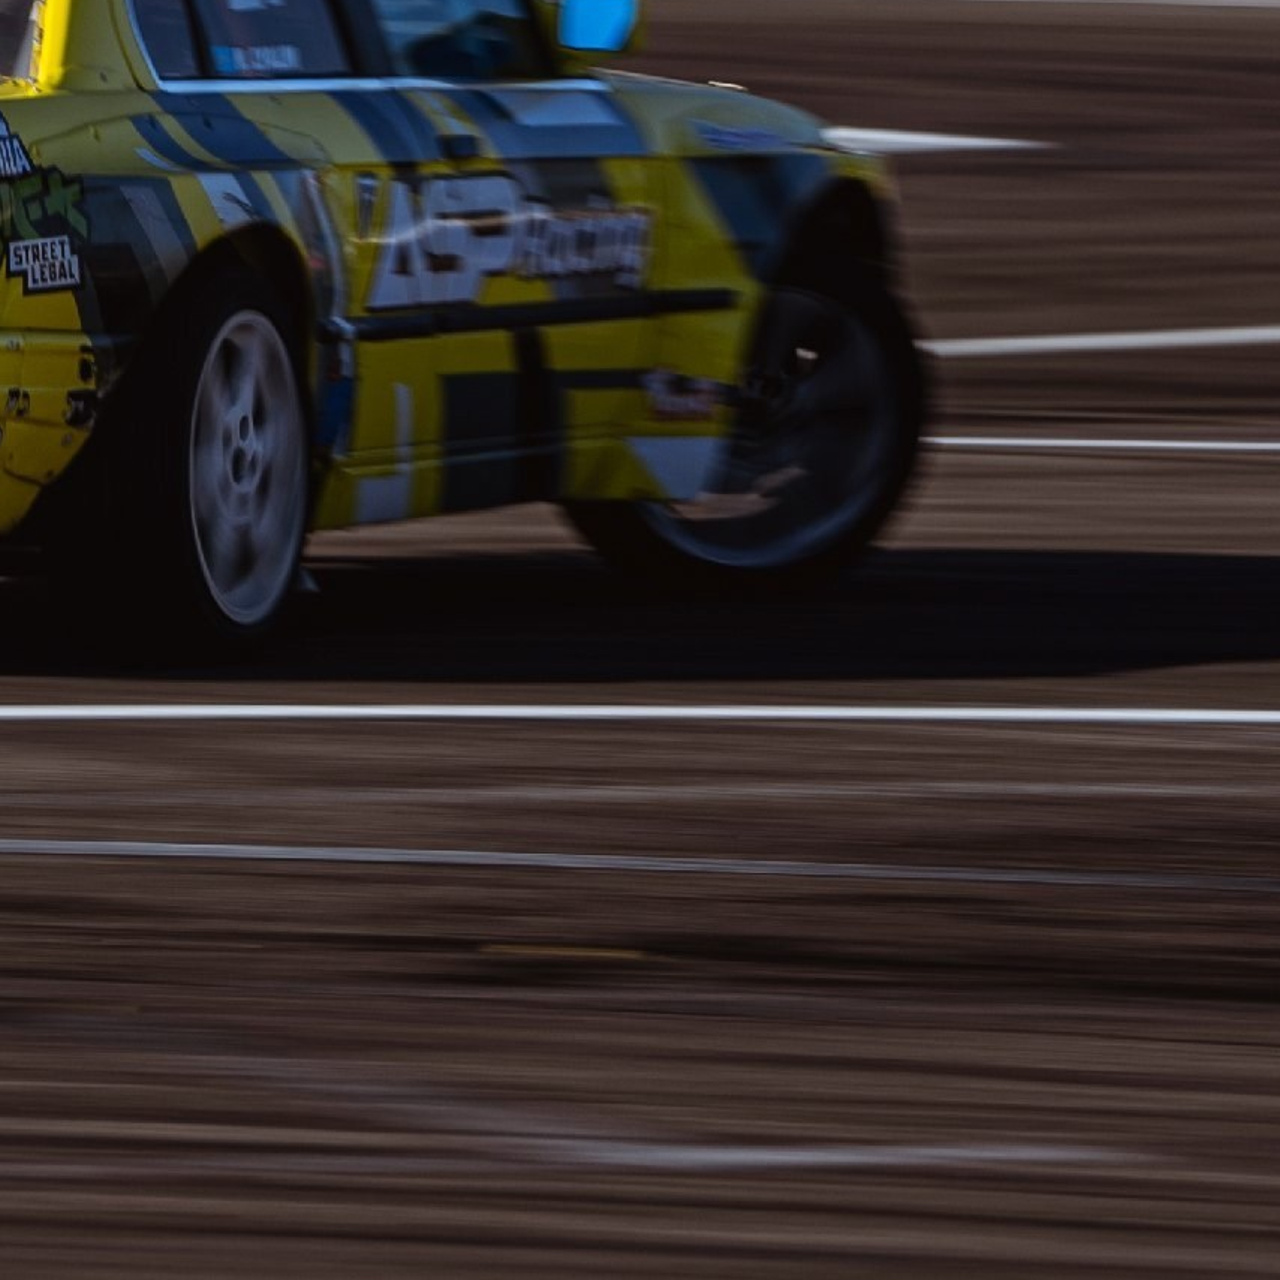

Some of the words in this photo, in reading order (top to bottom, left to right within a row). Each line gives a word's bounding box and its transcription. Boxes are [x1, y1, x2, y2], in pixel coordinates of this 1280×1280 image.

[13, 240, 67, 267] STREET
[366, 175, 520, 310] ASP
[517, 194, 650, 291] Racing
[31, 262, 76, 285] LEGAL
